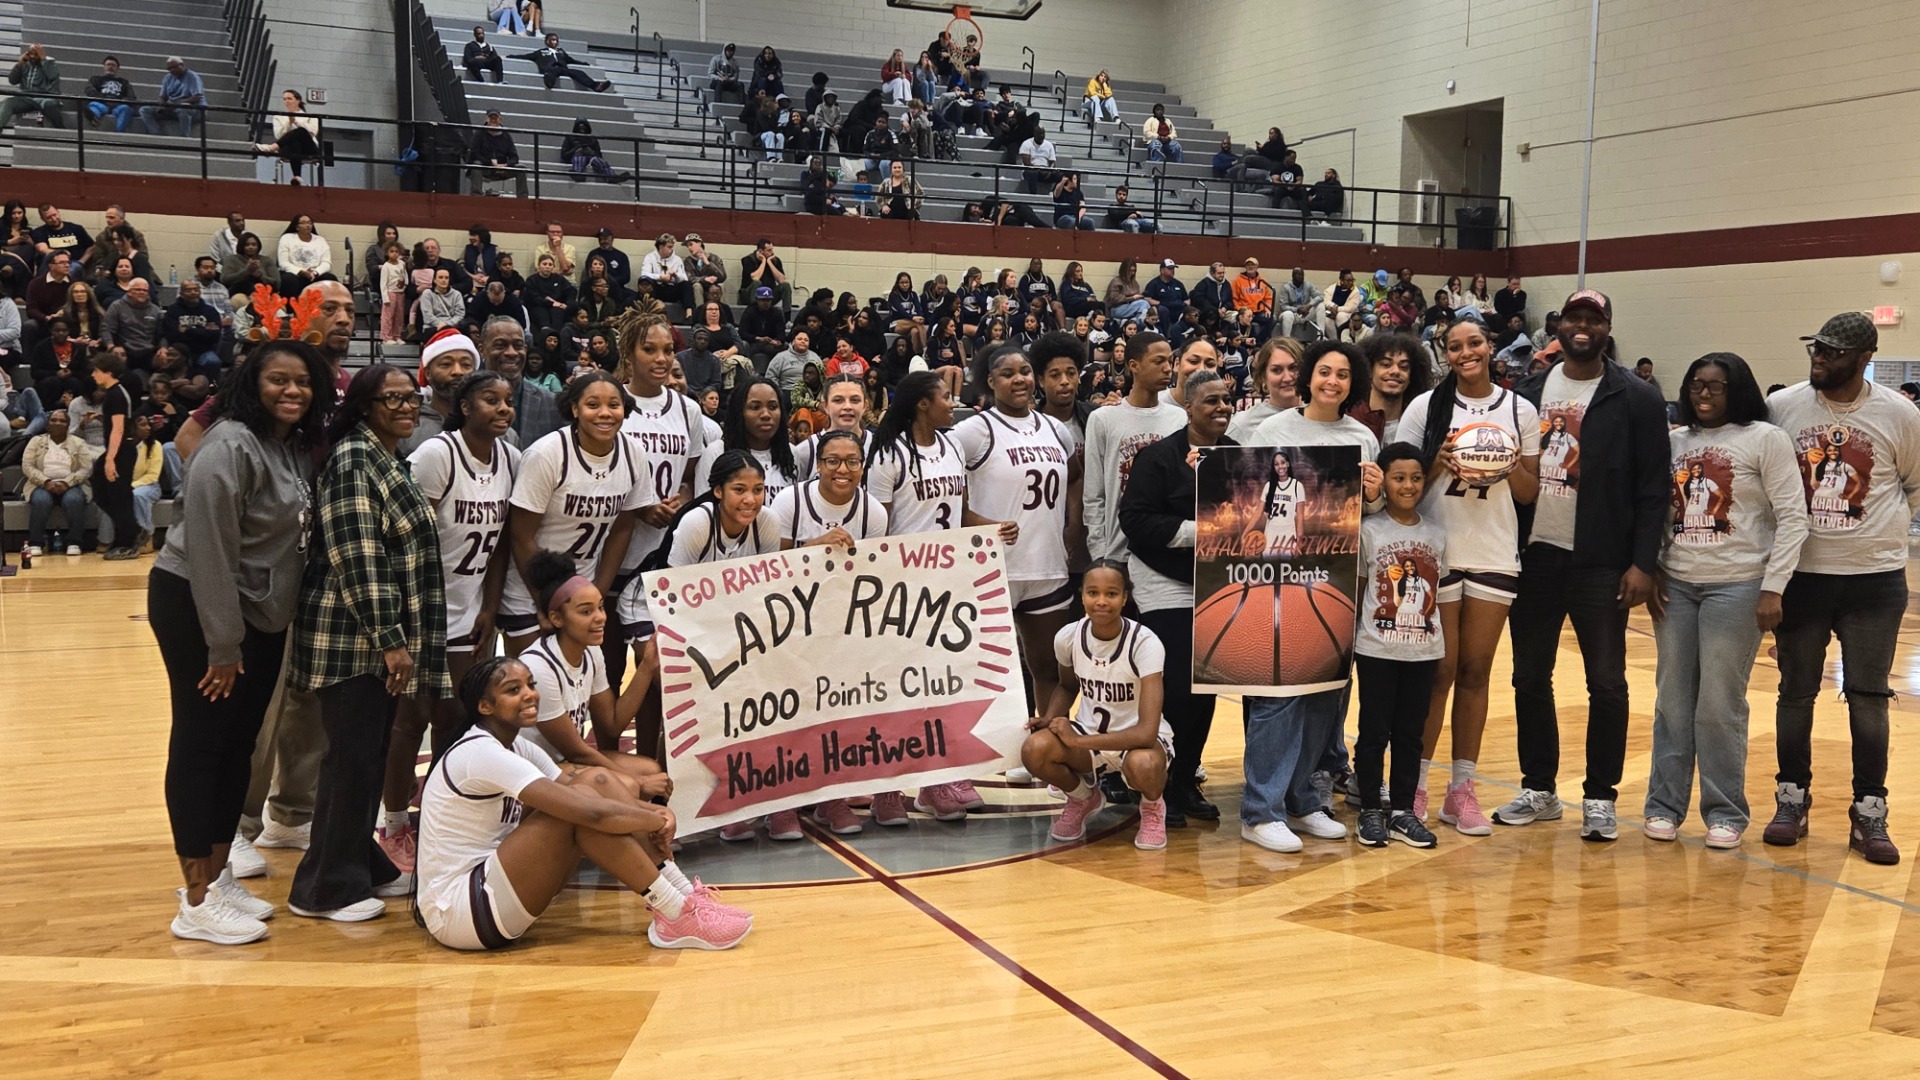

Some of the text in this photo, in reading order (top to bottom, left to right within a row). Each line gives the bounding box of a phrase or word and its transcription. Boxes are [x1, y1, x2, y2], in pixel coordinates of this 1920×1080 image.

[625, 431, 687, 456] STSIDE
[1006, 445, 1066, 467] WESTSIDE
[1460, 452, 1490, 463] RAMS
[648, 460, 673, 502] 0
[1540, 465, 1568, 481] HALIA
[913, 474, 963, 501] WESTSID
[1022, 468, 1060, 511] 30
[1540, 484, 1571, 498] TWELL
[454, 499, 508, 525] WESTSID
[564, 493, 627, 518] WESTSID
[935, 502, 951, 530] 3
[1811, 497, 1850, 512] KHALIA
[452, 530, 500, 576] 25
[564, 522, 610, 560] 21
[1270, 534, 1360, 557] HARTWELL
[899, 543, 955, 570] WHS
[681, 554, 794, 608] GO RAMS!
[1225, 563, 1330, 584] 1000 Points
[1406, 592, 1417, 604] 24
[686, 574, 978, 691] LADY RAMS
[1383, 630, 1432, 644] HARTWELL
[723, 665, 964, 738] 1,000 Points Club
[1079, 677, 1135, 703] ESTSIDE
[726, 718, 947, 800] Khalia Hartwell
